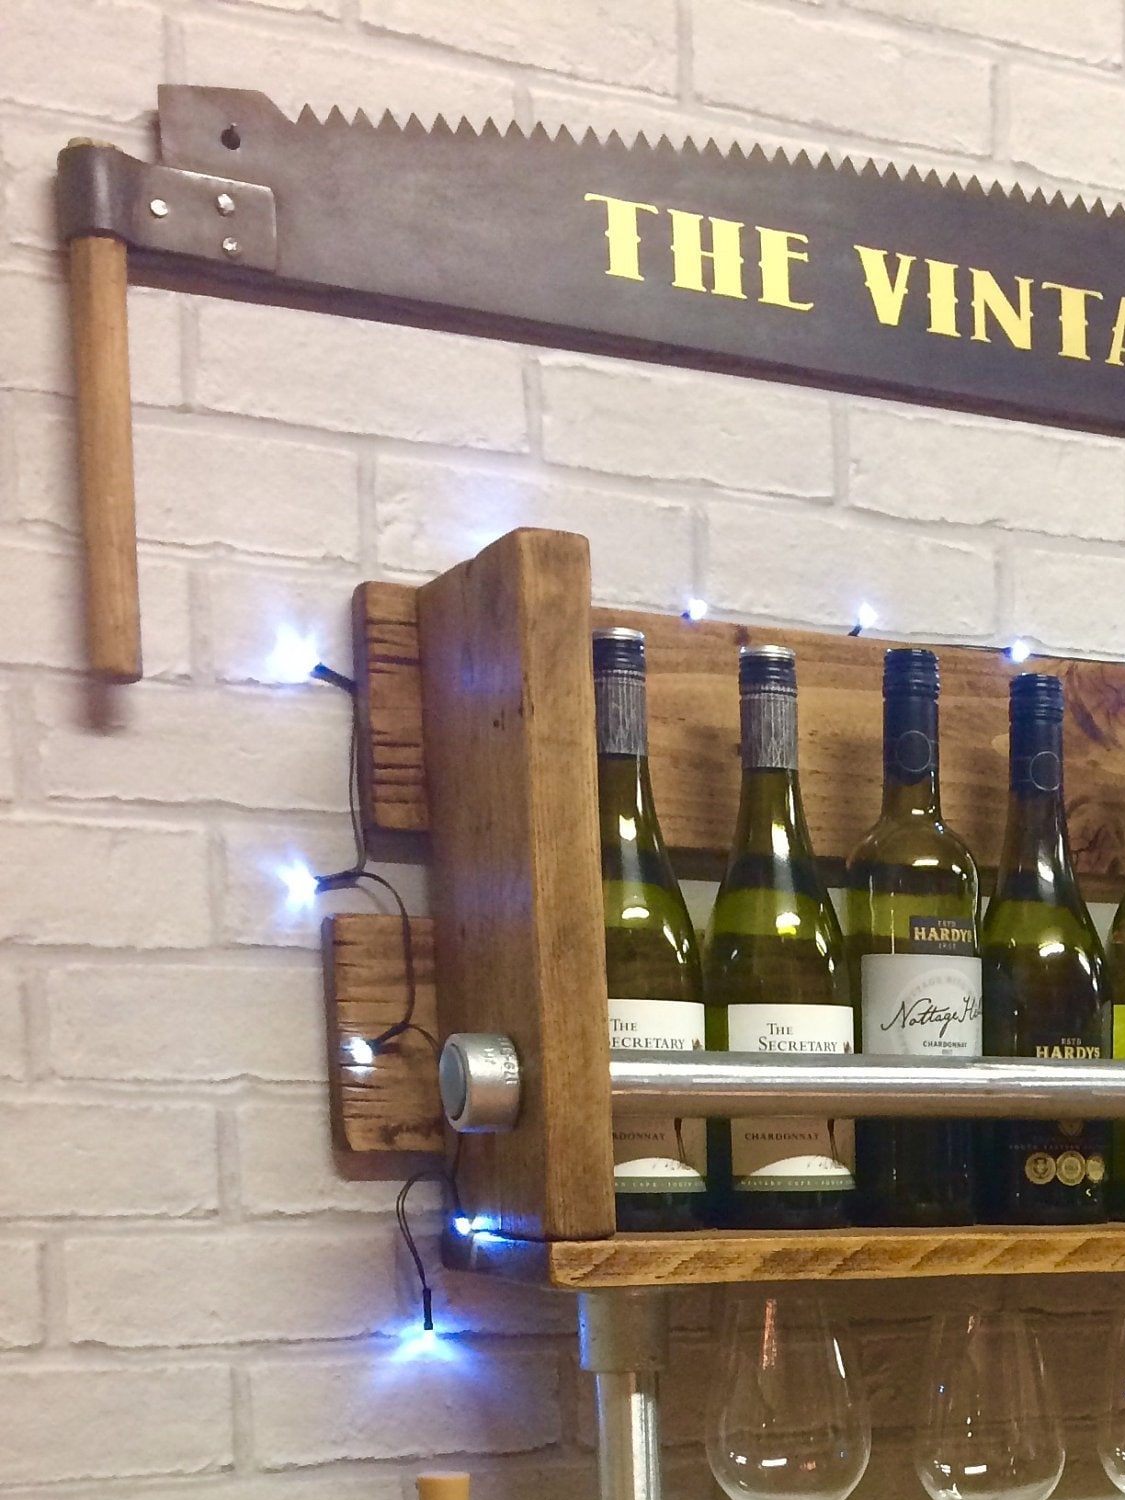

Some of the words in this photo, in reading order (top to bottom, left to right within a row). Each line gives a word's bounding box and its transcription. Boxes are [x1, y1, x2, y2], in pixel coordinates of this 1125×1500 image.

[584, 191, 817, 312] THE
[913, 927, 973, 943] HARDYS
[880, 997, 959, 1038] Nottage
[609, 1036, 685, 1050] ECRETARY
[758, 1035, 838, 1052] SECRETARY
[922, 1039, 968, 1048] CHARDONNAY
[1035, 1045, 1101, 1060] HARDYS
[612, 1131, 666, 1141] RDONNAY
[744, 1132, 820, 1141] CHARDONNAY
